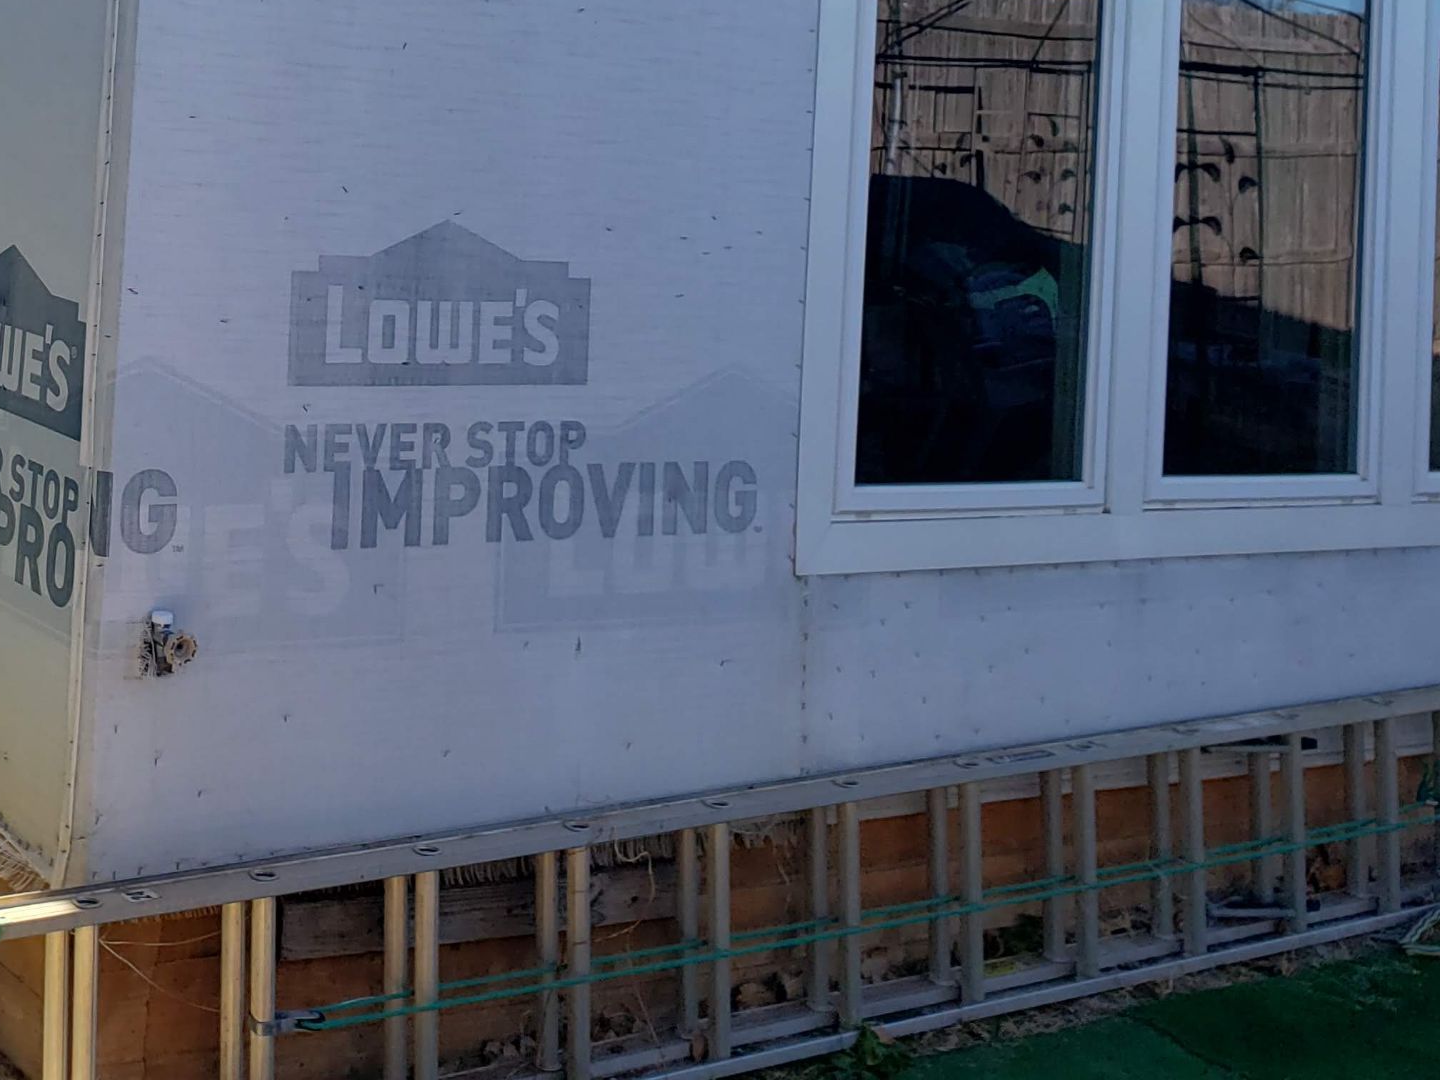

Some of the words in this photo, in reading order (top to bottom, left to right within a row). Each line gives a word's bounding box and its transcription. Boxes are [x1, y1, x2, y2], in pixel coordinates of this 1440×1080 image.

[326, 284, 560, 368] LOWE'S
[283, 423, 449, 475] NEVER
[465, 421, 586, 469] STOP
[11, 454, 79, 523] STOP
[330, 460, 758, 550] IMPROVING
